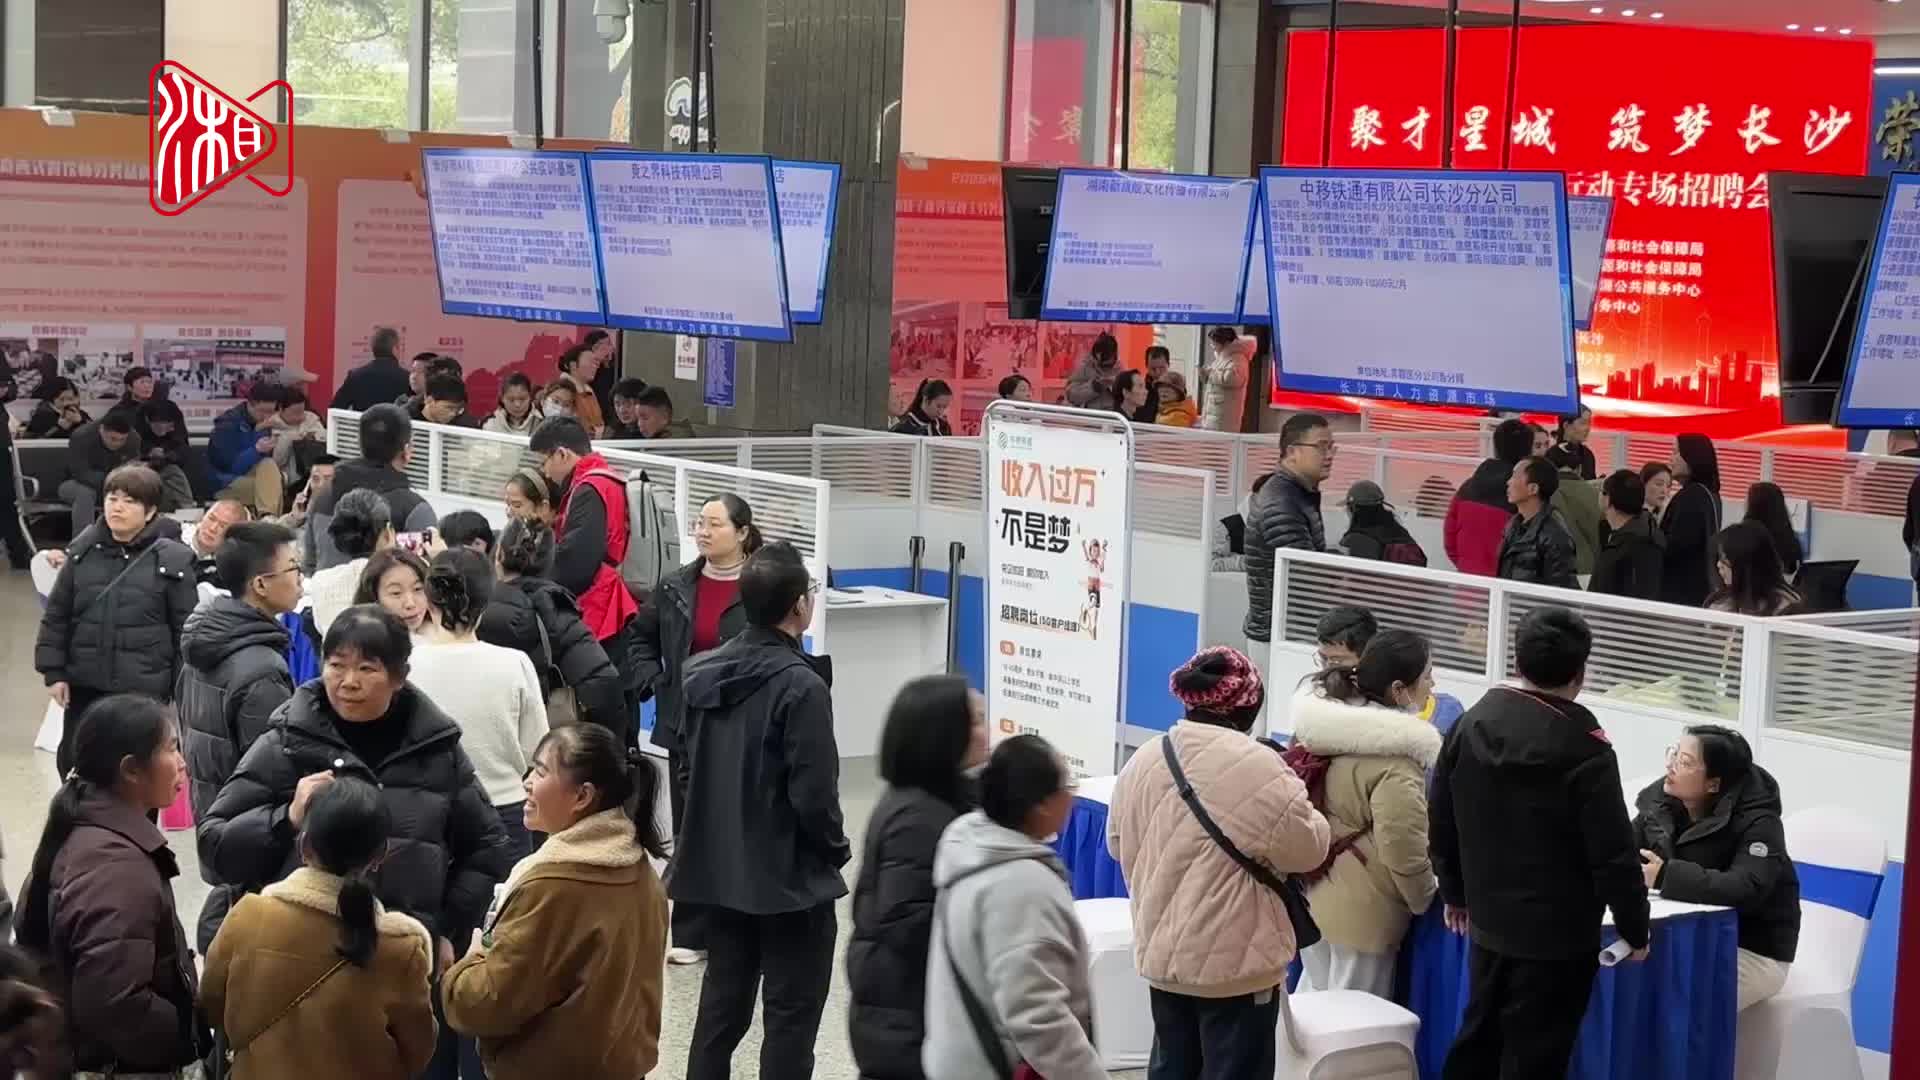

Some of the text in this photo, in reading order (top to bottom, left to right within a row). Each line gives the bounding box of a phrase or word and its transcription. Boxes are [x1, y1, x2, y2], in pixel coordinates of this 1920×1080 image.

[1349, 103, 1852, 156] 聚才星城 筑梦长沙
[1299, 178, 1518, 206] 中移铁通有限公司长沙分公司
[1594, 297, 1641, 314] 务中心
[1339, 380, 1496, 407] 长沙市人力资源市场
[1001, 459, 1097, 508] 收入过万
[1001, 508, 1071, 554] 不是梦
